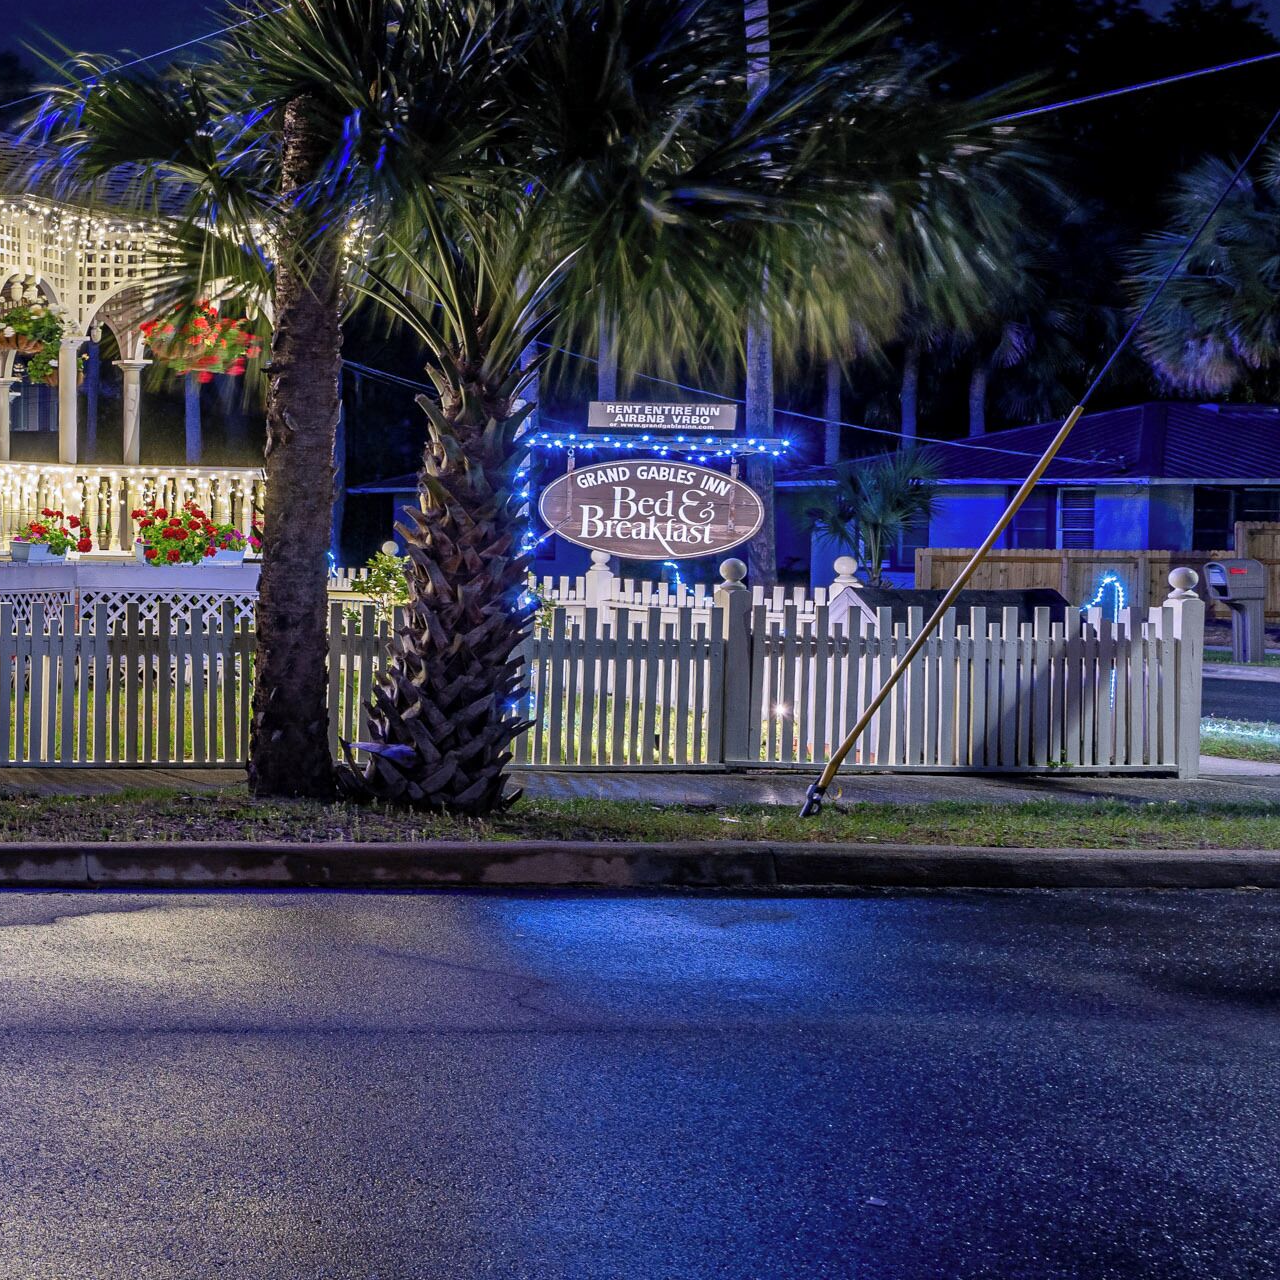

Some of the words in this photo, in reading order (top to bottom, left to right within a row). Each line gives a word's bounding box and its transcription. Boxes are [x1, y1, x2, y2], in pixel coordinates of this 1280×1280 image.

[606, 404, 642, 414] RENT
[644, 405, 692, 415] ENTIRE
[695, 406, 720, 416] INN
[614, 414, 665, 423] AIRBNB
[672, 415, 711, 424] VRBO
[576, 466, 630, 489] GRAND
[636, 466, 696, 485] GABLES
[699, 475, 732, 497] INN
[609, 486, 675, 520] Bed
[678, 489, 715, 525] &
[578, 504, 714, 554] Breakfast
